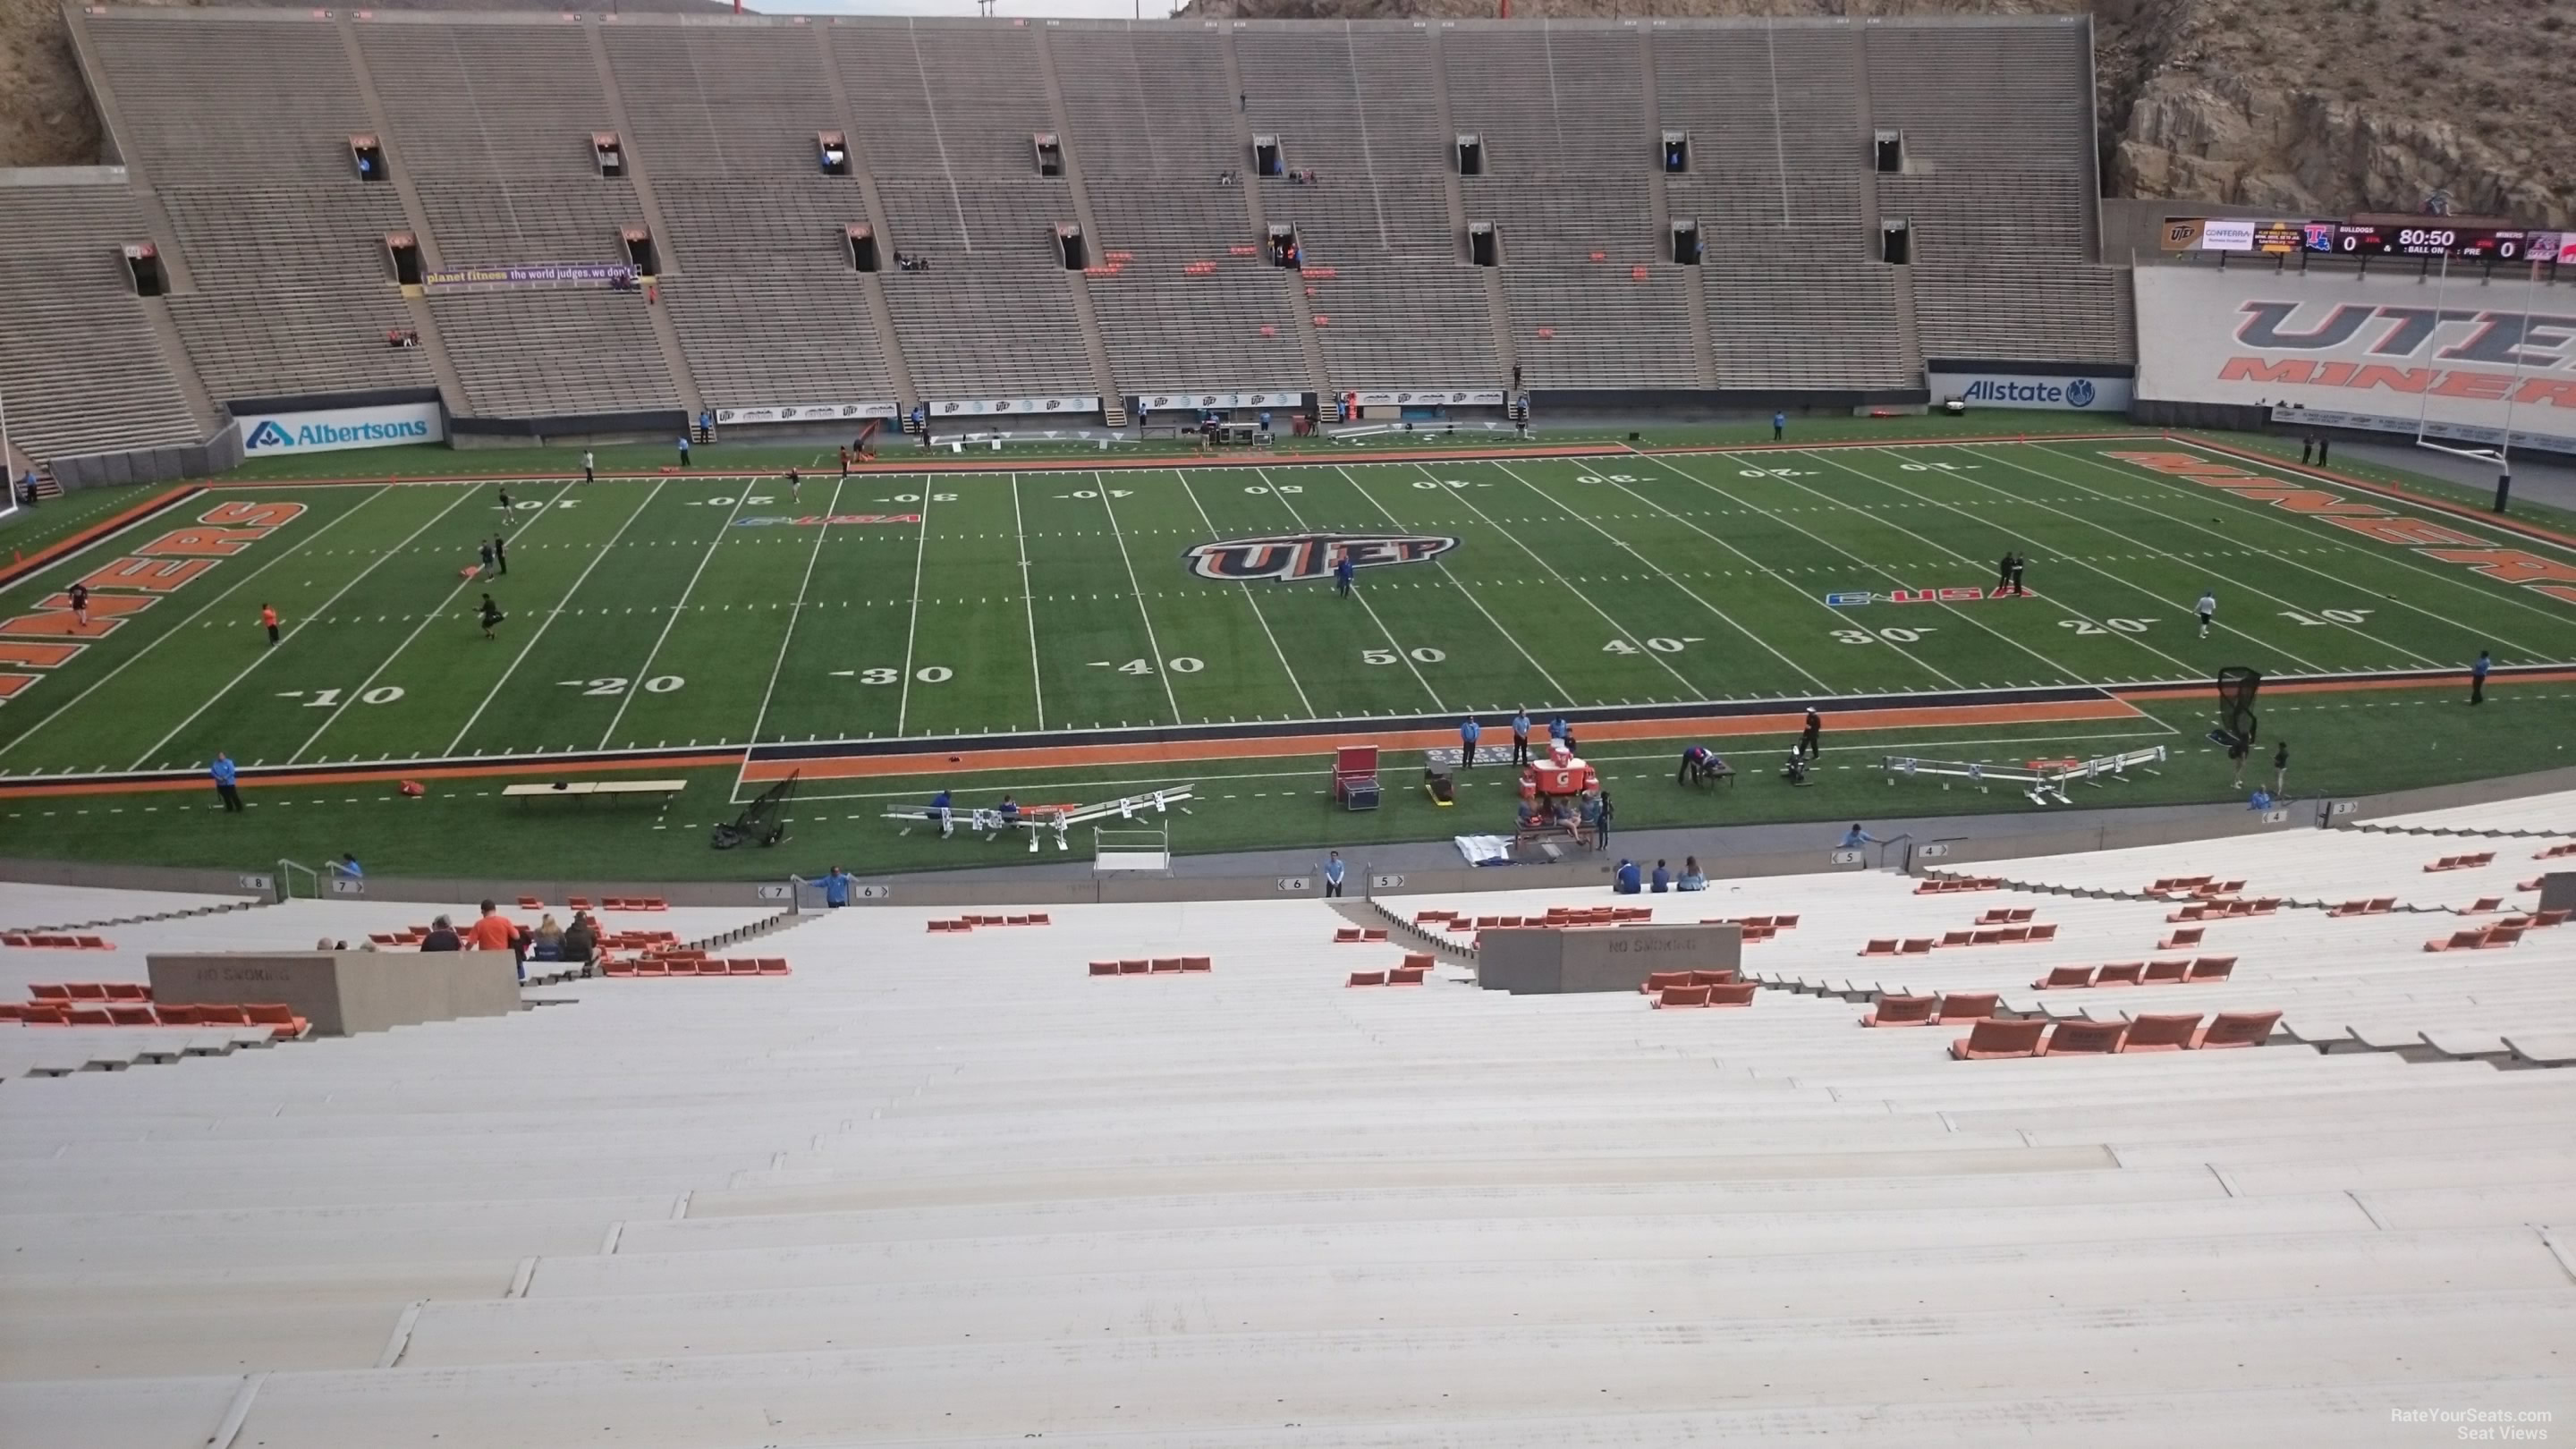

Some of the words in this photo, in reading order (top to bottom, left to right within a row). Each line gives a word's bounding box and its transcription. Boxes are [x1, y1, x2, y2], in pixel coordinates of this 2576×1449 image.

[2343, 236, 2356, 251] 0
[2399, 229, 2454, 246] 80:50
[2463, 248, 2481, 256] PRE
[2500, 242, 2514, 258] 0
[427, 272, 465, 285] planet
[467, 271, 507, 282] fitness
[511, 270, 526, 280] the
[529, 268, 555, 279] world
[2233, 301, 2576, 372] UTE
[1962, 380, 2062, 402] Allstate
[298, 419, 428, 446] Albertsons
[1182, 533, 1458, 581] UTEP
[2277, 609, 2364, 626] 10
[2058, 617, 2148, 635] 20
[1829, 627, 1921, 645] 30
[1602, 638, 1685, 655] 40
[1362, 648, 1446, 665] 50
[1117, 657, 1205, 675] 40
[860, 666, 953, 685] 30
[582, 675, 686, 696] 20
[302, 686, 405, 707] 10
[1556, 771, 1569, 785] G
[2339, 804, 2344, 812] 3
[2273, 812, 2279, 821] 4
[1846, 852, 1852, 862] 5
[1925, 846, 1932, 855] 4
[256, 878, 262, 887] 8
[339, 882, 346, 891] 7
[1293, 879, 1301, 888] 6
[1381, 877, 1387, 886] 5
[775, 887, 783, 896] 7
[864, 887, 872, 896] 6
[1609, 939, 1628, 953] NO
[198, 968, 218, 981] NO
